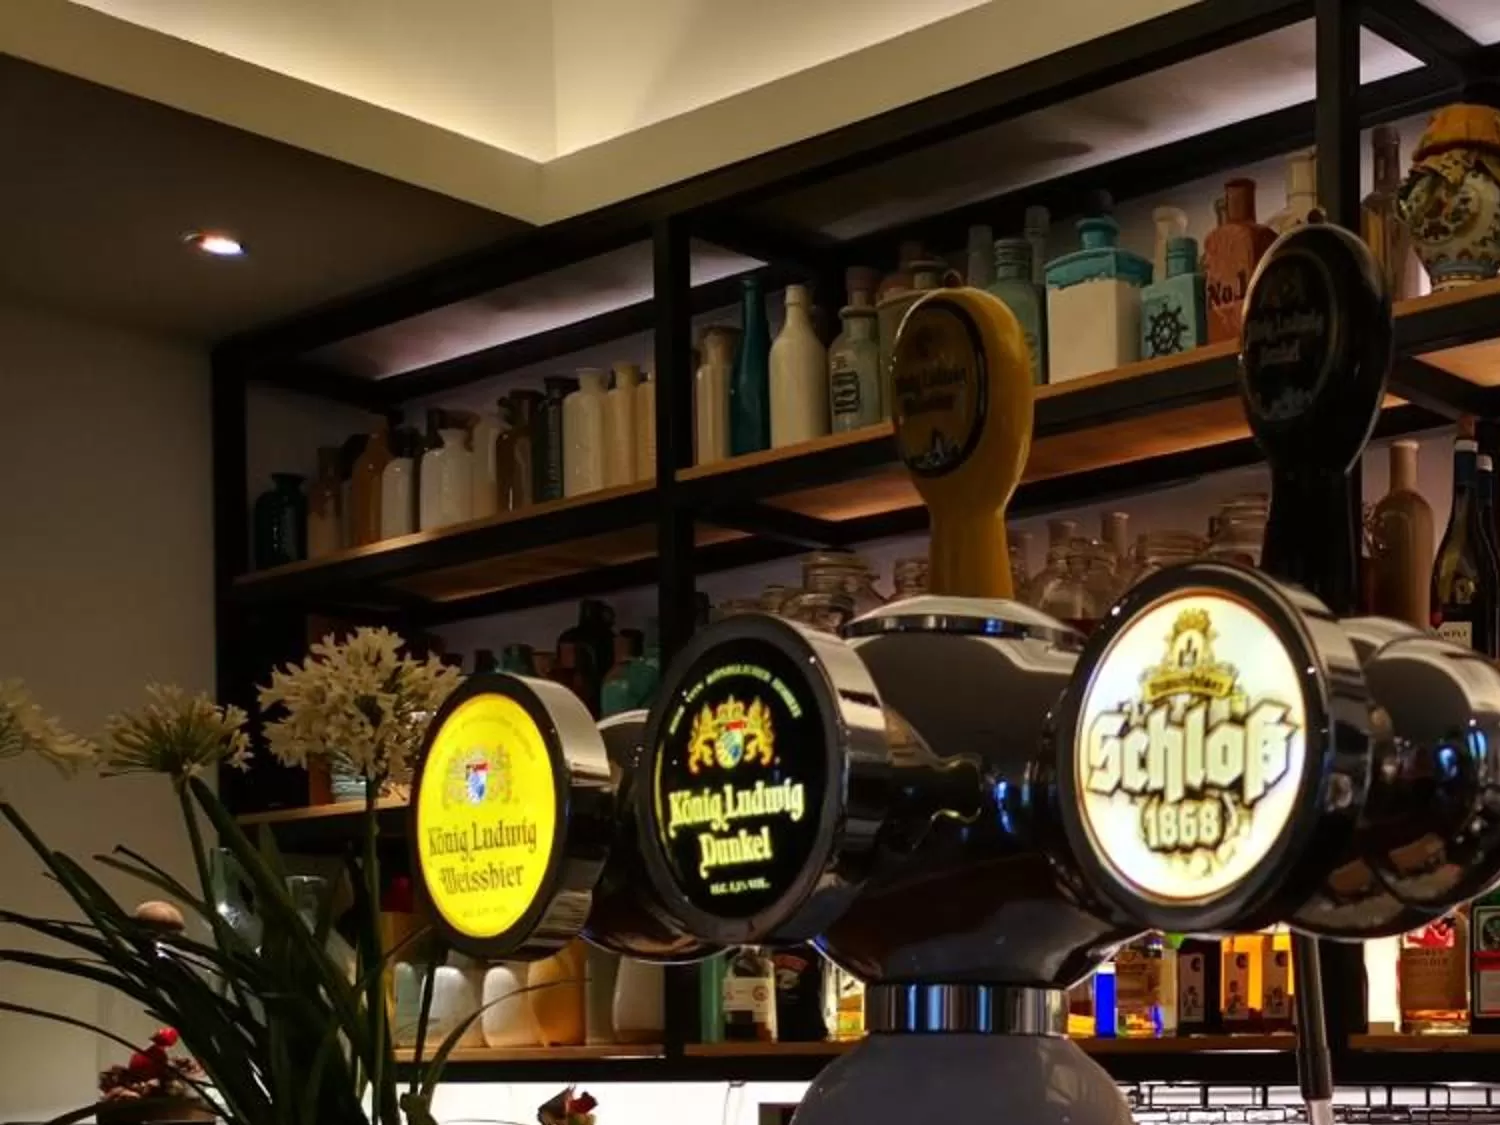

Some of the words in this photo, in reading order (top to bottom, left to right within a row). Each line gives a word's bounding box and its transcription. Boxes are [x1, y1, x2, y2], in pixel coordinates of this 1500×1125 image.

[668, 786, 722, 838] König
[723, 777, 804, 831] Ludwig
[1143, 802, 1222, 852] 1868
[470, 819, 537, 862] Ludwig
[698, 825, 773, 880] Dunkel
[440, 864, 525, 895] Weissbier
